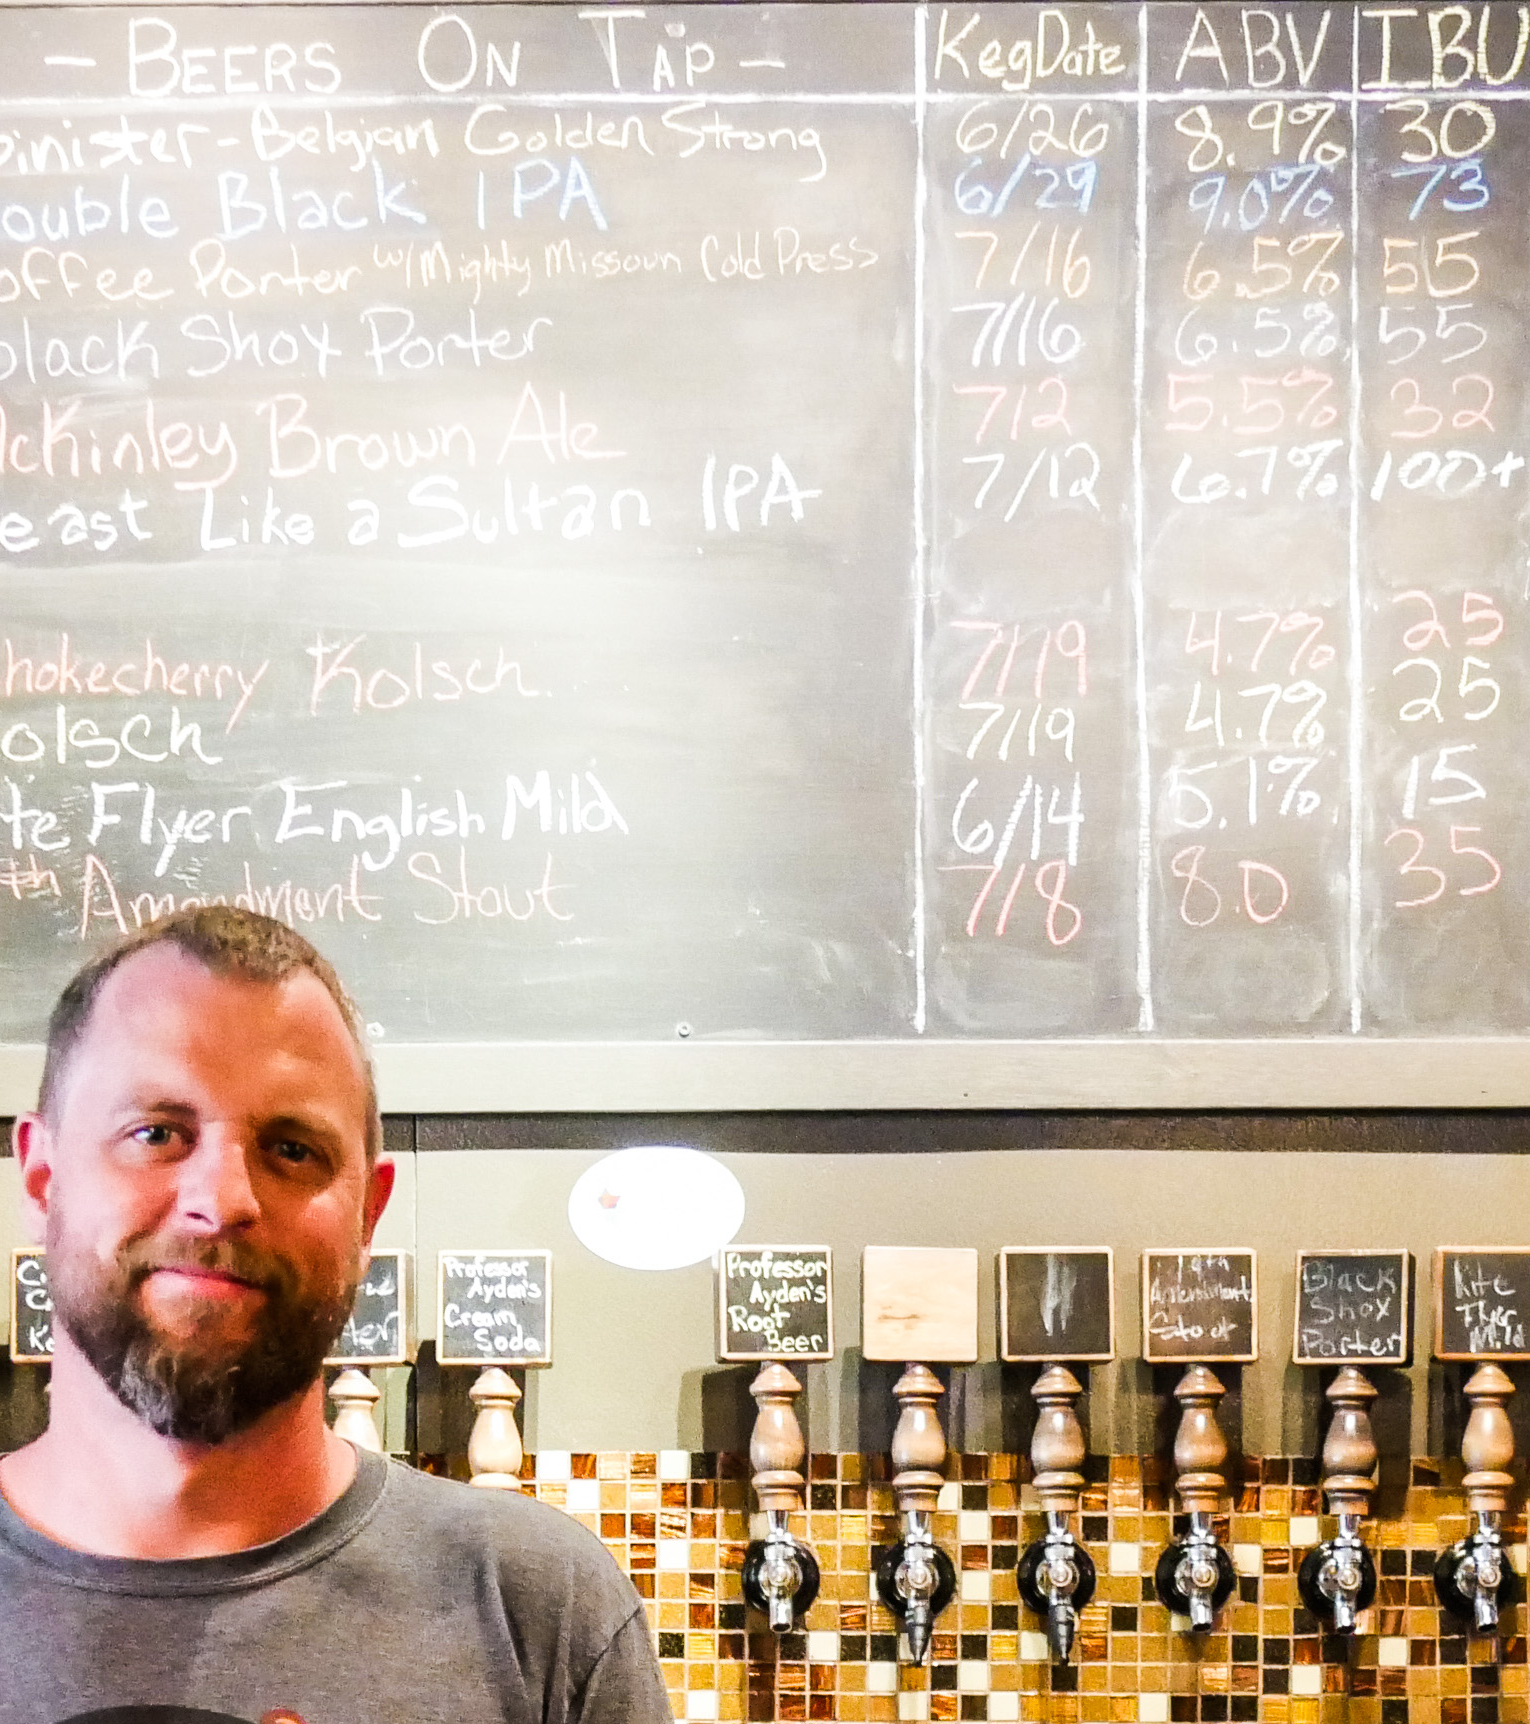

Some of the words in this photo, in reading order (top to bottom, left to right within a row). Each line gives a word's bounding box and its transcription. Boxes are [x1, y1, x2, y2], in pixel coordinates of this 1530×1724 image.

[128, 17, 341, 97] BEERS
[418, 14, 520, 92] ON
[577, 9, 715, 91] TAP
[1176, 9, 1331, 88] ABV
[1361, 5, 1530, 90] IBU
[464, 104, 655, 156] Golden
[661, 102, 827, 183] Strong
[956, 102, 1108, 159] 6/26
[1176, 102, 1345, 172] 8.9%
[1380, 101, 1496, 163] 30
[218, 157, 426, 241] Black
[479, 155, 608, 231] IPA
[954, 152, 1097, 217] 6/29
[1189, 164, 1333, 234] 9.0%
[1391, 156, 1490, 221] 73
[189, 238, 362, 298] Porter
[955, 221, 1091, 299] 7/16
[1383, 231, 1479, 297] 55
[360, 306, 553, 376] Porter
[1379, 304, 1488, 364] 55
[254, 392, 476, 478] Brown
[497, 380, 627, 463] Ale
[1165, 366, 1337, 433] 5.5%
[1391, 373, 1495, 438] 32
[199, 487, 316, 552] Like
[346, 499, 380, 548] a
[397, 474, 651, 549] Sultan
[701, 453, 822, 531] IPA
[962, 442, 1100, 522] 7/12
[1370, 451, 1525, 500] 100+
[1393, 590, 1504, 651] 25
[1393, 656, 1500, 722] 25
[1402, 744, 1486, 819] 15
[87, 778, 250, 878] Flyer
[274, 778, 485, 872] English
[500, 770, 629, 841] Mild
[953, 771, 1085, 868] 6/14
[407, 850, 574, 925] Stout
[1384, 826, 1502, 907] 35
[444, 1257, 530, 1278] Professor
[468, 1281, 541, 1303] Ayden's
[727, 1253, 827, 1279] Professor
[749, 1279, 827, 1307] Ayden's
[1302, 1261, 1398, 1295] Black
[1455, 1260, 1516, 1298] Kite
[445, 1304, 519, 1329] Cream
[474, 1329, 540, 1352] Soda
[728, 1305, 790, 1334] Root
[766, 1331, 822, 1352] Beer
[1302, 1330, 1401, 1358] Porter
